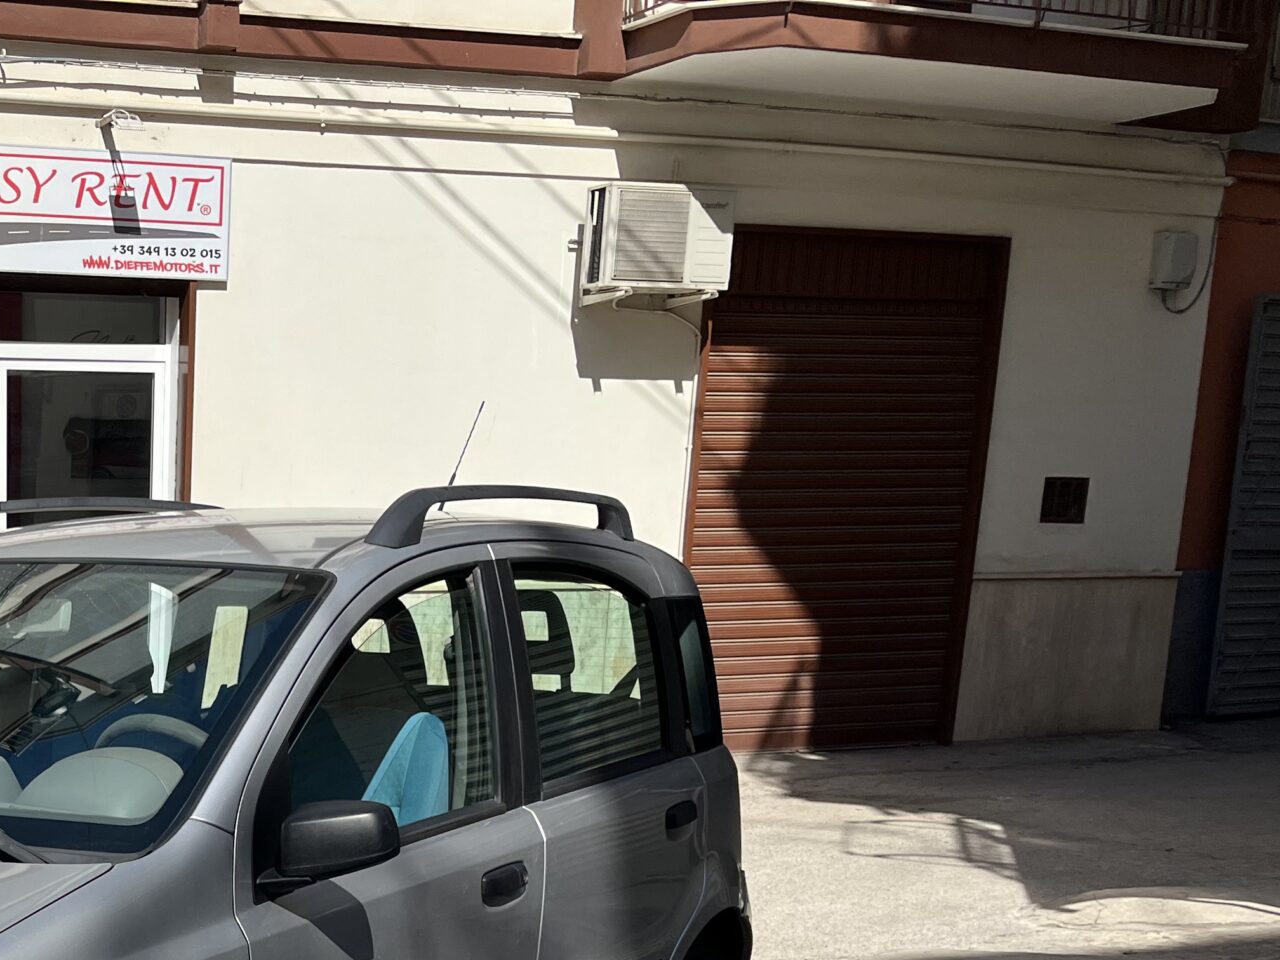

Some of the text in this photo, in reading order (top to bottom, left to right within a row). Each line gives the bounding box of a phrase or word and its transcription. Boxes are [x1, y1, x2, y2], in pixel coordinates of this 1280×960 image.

[71, 171, 215, 213] RENT
[112, 245, 222, 259] +39 349 13 02 015
